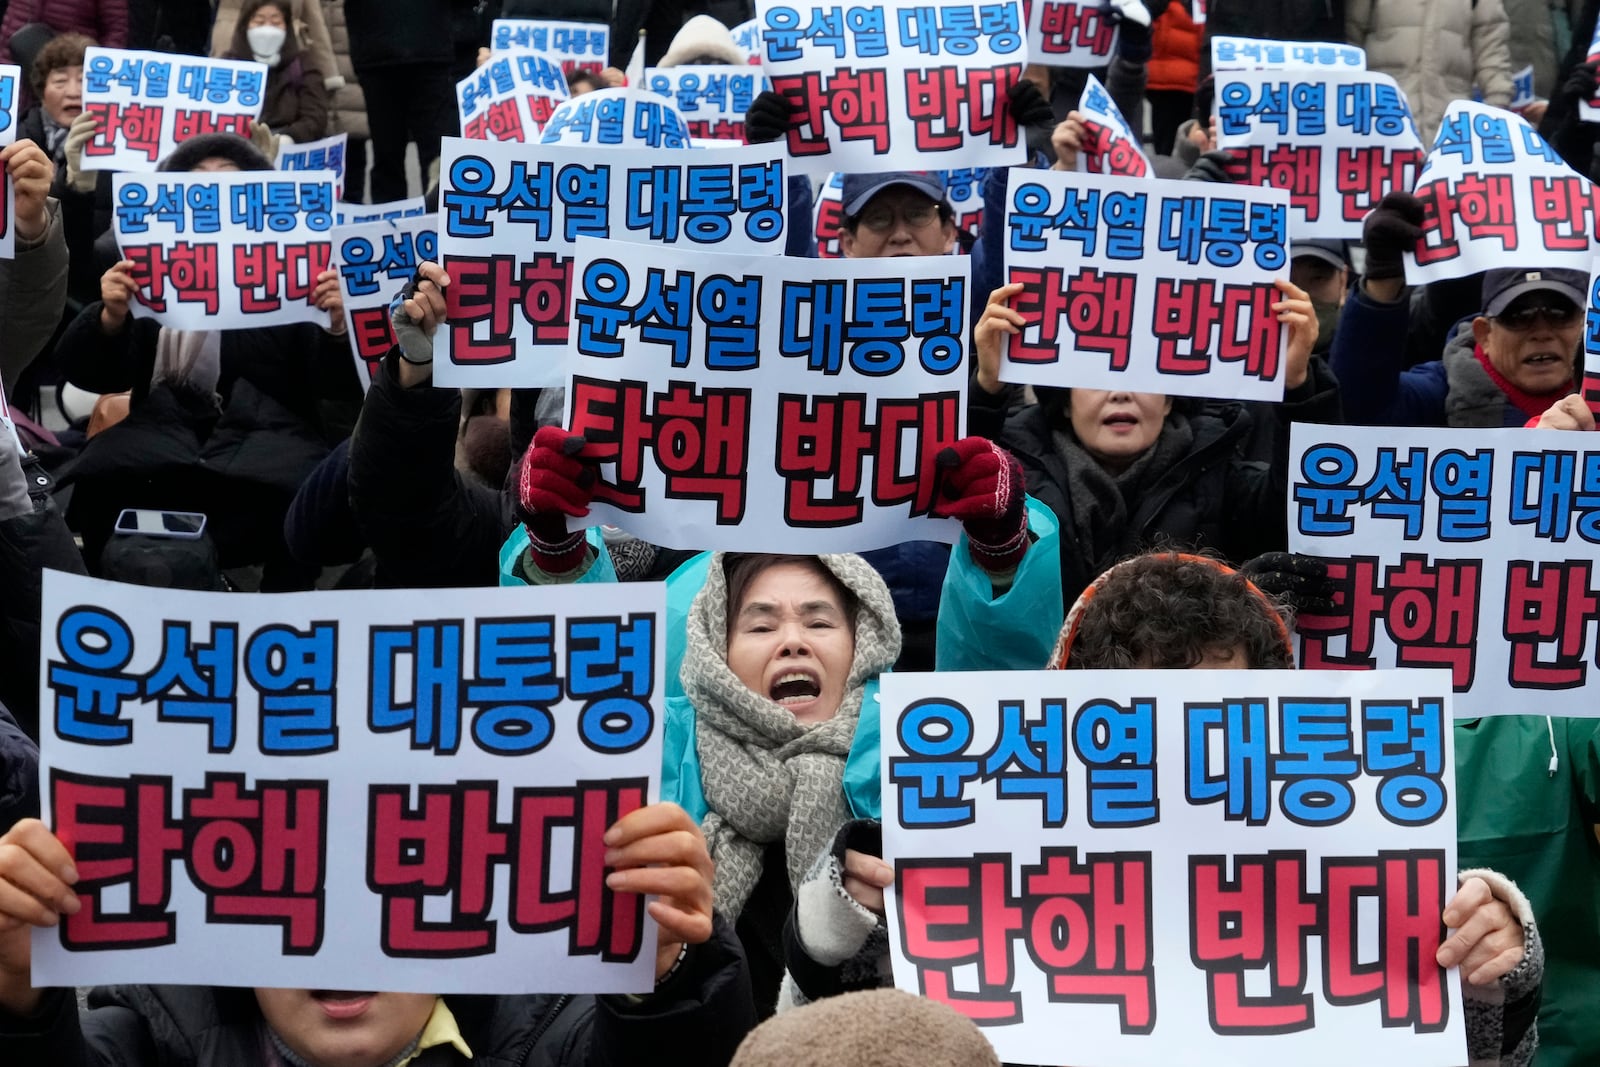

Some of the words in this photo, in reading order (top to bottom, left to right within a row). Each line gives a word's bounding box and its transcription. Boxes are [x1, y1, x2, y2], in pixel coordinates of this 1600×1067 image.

[763, 6, 888, 62] 윤석열
[897, 2, 1021, 55] 대통령
[1041, 0, 1115, 56] 반대
[85, 56, 171, 98] 윤석열
[177, 65, 262, 106] 대통령
[462, 58, 515, 117] 윤석열
[540, 98, 626, 144] 윤석열
[634, 101, 692, 149] 대통
[676, 73, 754, 113] 윤석열
[770, 67, 890, 157] 탄핵
[904, 63, 1023, 152] 반대
[1220, 81, 1326, 135] 윤석열
[1337, 83, 1423, 142] 대통
[85, 102, 163, 162] 탄핵
[1424, 112, 1515, 173] 석열
[117, 183, 221, 233] 윤석열
[230, 182, 333, 232] 대통령
[444, 155, 610, 242] 윤석열
[626, 159, 783, 242] 대통령
[1008, 183, 1148, 260] 윤석열
[1158, 196, 1287, 271] 대통령
[1414, 172, 1518, 266] 탄핵
[1530, 176, 1600, 251] 반
[122, 241, 219, 315] 탄핵
[233, 241, 332, 314] 반대
[575, 258, 762, 370] 윤석열
[778, 276, 966, 376] 대통령
[1008, 266, 1137, 371] 탄핵
[1152, 277, 1284, 382] 반대
[570, 375, 751, 525] 탄핵
[775, 390, 960, 528] 반대
[1293, 443, 1495, 541] 윤석열
[1293, 551, 1483, 693] 탄핵
[1503, 559, 1600, 690] 반
[48, 605, 339, 756] 윤석열
[367, 612, 656, 756] 대통령
[889, 697, 1160, 829] 윤석열
[1183, 697, 1448, 827] 대통령
[50, 767, 328, 956] 탄핵
[366, 776, 649, 962] 반대
[895, 845, 1157, 1036] 탄핵
[1188, 849, 1449, 1036] 반대
